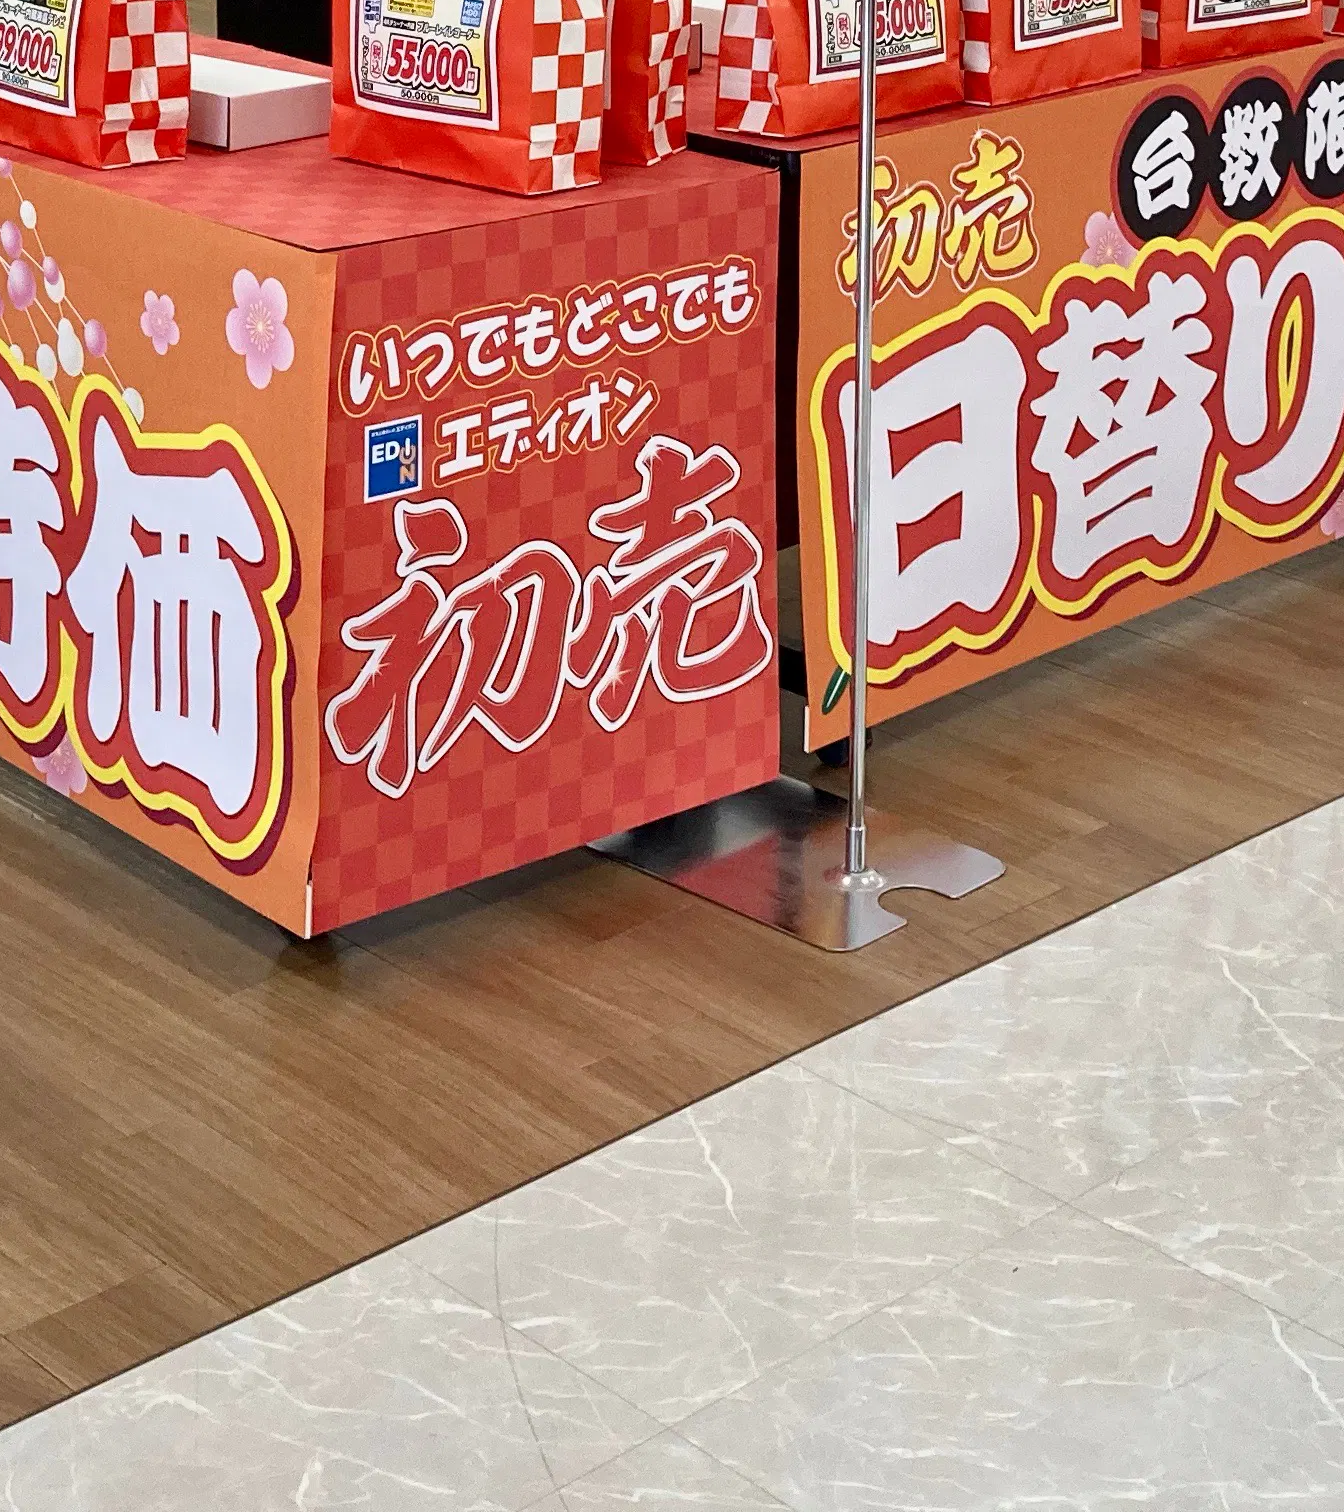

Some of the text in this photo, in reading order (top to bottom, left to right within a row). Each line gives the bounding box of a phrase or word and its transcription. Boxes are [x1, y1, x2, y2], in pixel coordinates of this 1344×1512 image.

[386, 37, 476, 90] 55,000円
[416, 21, 481, 40] ブルーレイレコーダー
[838, 131, 1039, 298] 初売
[347, 264, 755, 407] いつでもどこでも
[439, 375, 654, 479] エディオン
[324, 436, 775, 798] 初売
